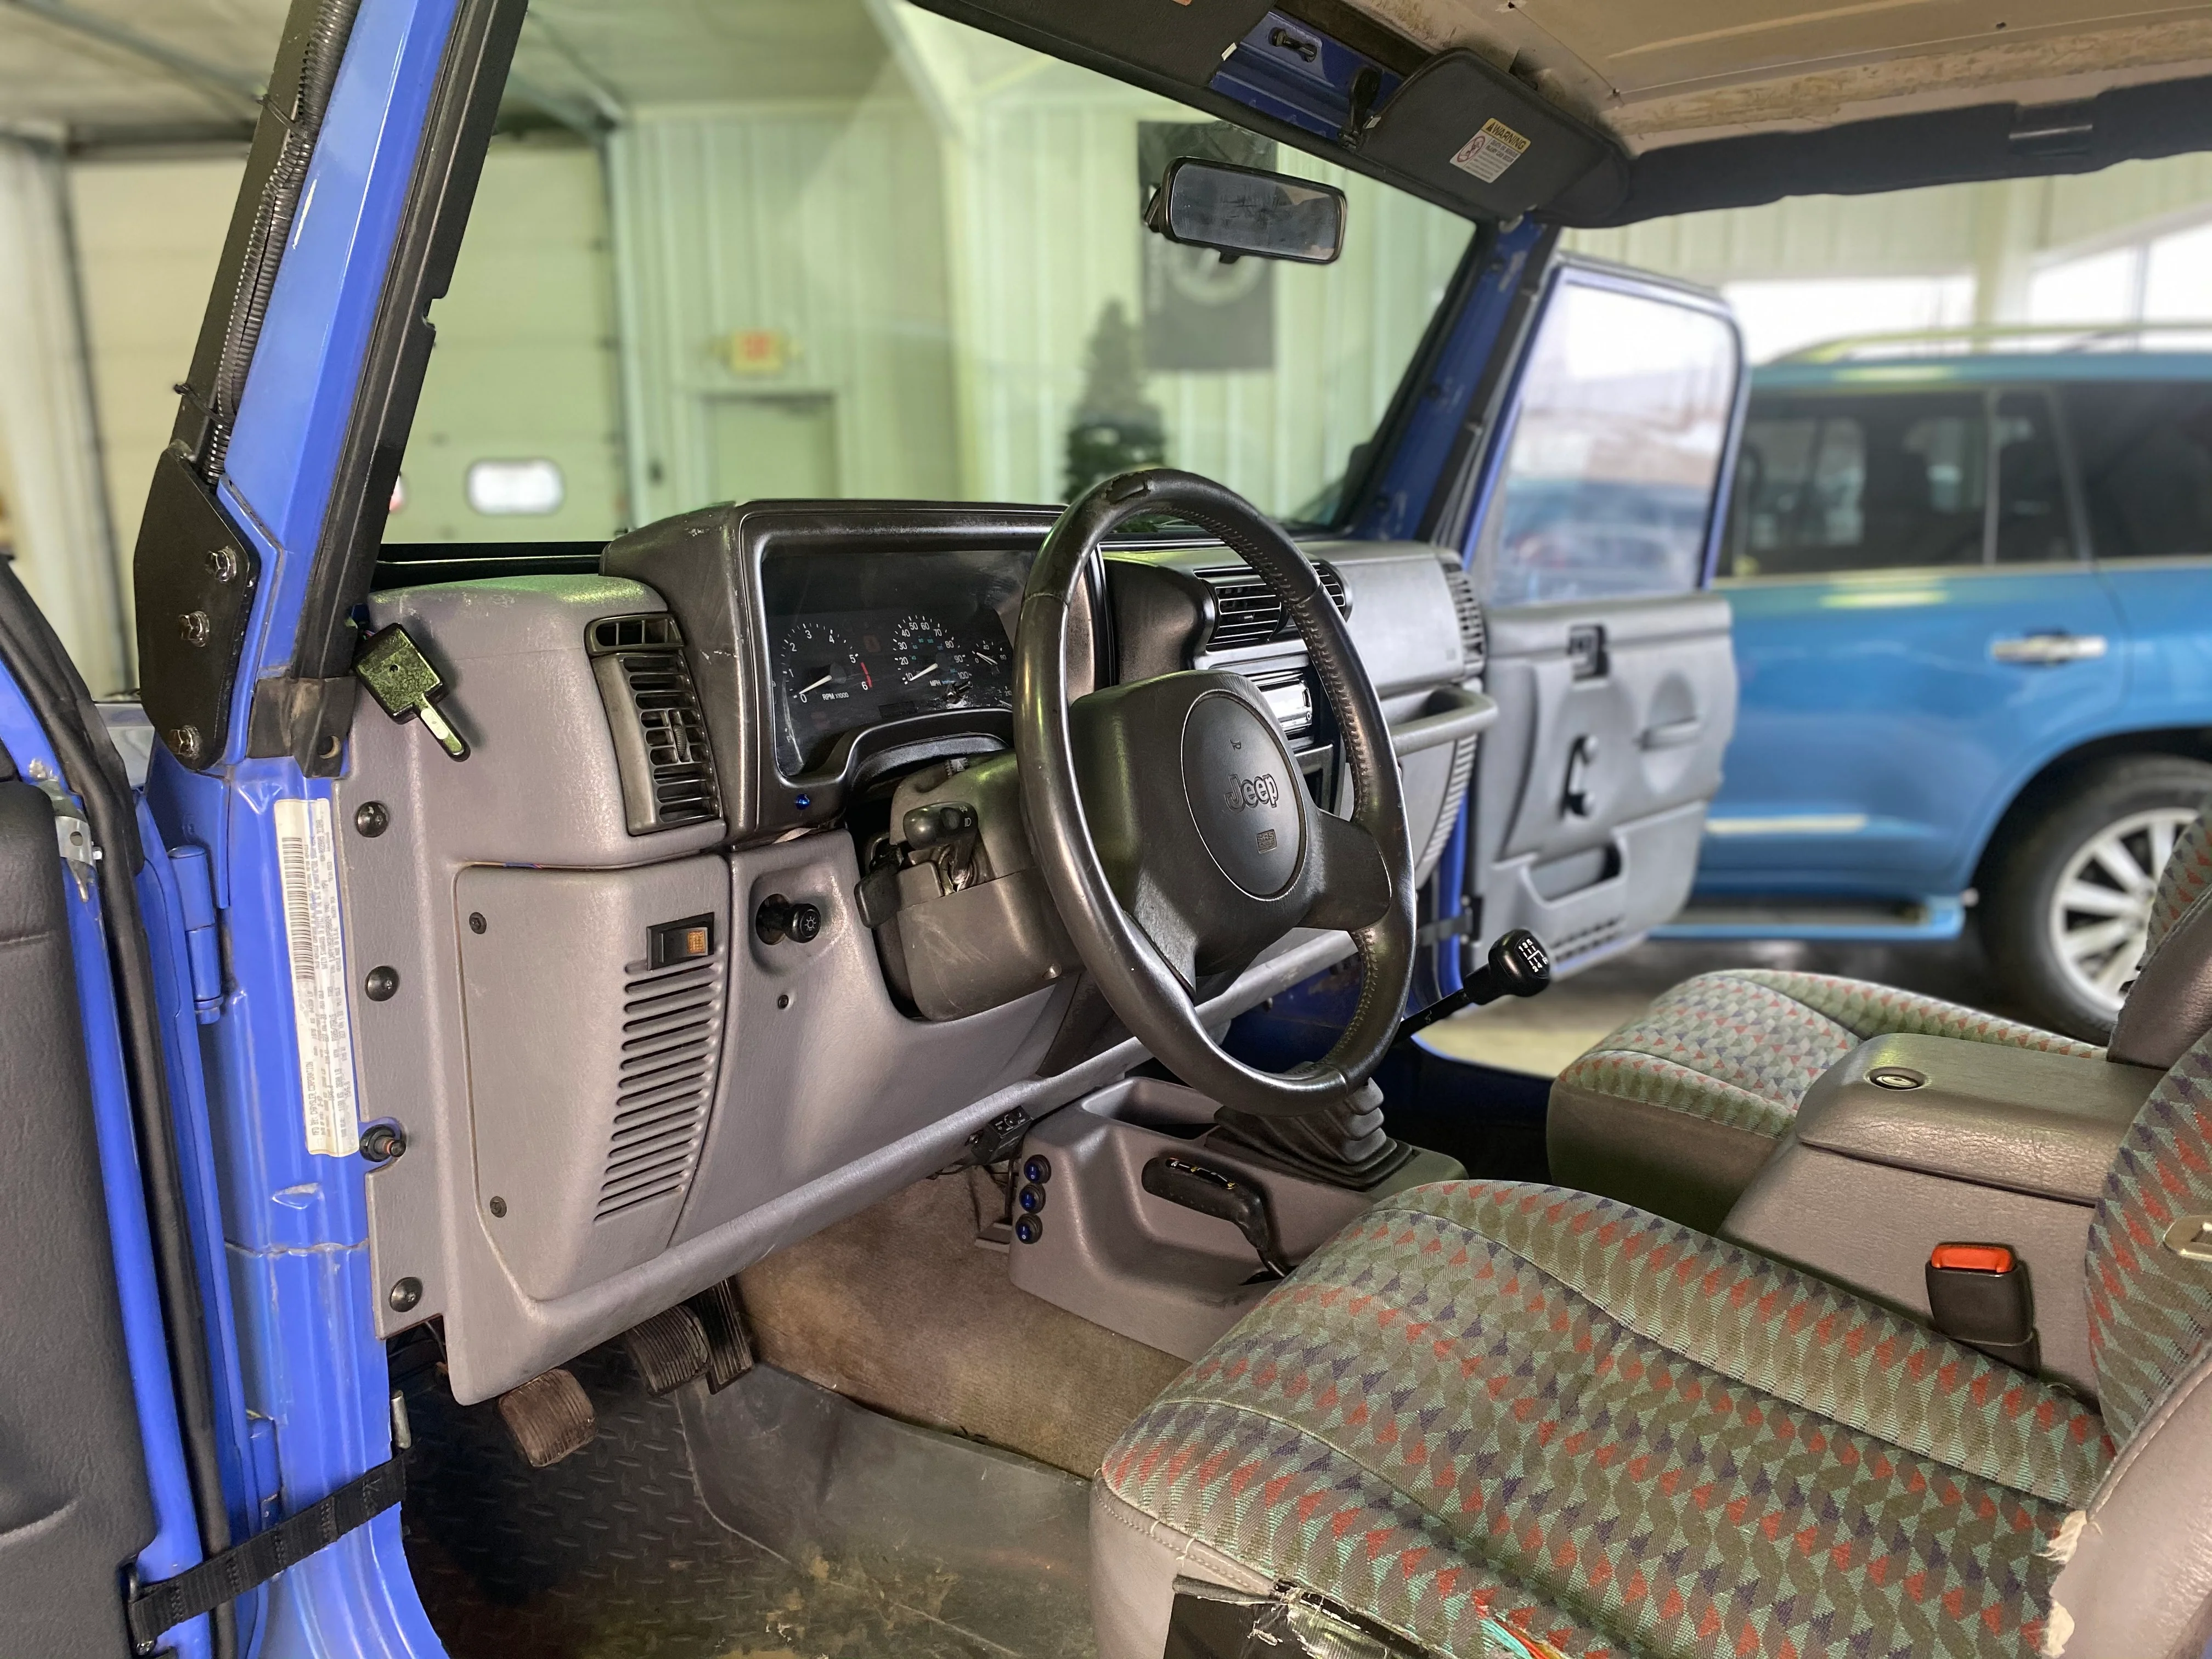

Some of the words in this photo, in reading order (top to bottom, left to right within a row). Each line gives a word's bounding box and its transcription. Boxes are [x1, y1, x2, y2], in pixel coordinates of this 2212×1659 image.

[1492, 123, 1527, 150] WARNING
[909, 622, 918, 630] 50
[921, 622, 930, 630] 60
[805, 630, 812, 639] 3
[934, 629, 943, 637] 70
[829, 635, 834, 644] 4
[945, 640, 954, 648] 80
[789, 642, 797, 652] 2
[898, 642, 907, 650] 30
[849, 654, 856, 663] 5
[899, 657, 909, 665] 20
[954, 654, 963, 663] 90
[788, 668, 794, 678] 1
[957, 671, 969, 680] 100
[861, 681, 868, 690] 6
[800, 694, 807, 703] 0
[1224, 774, 1279, 812] Jeep
[305, 1061, 315, 1091] CORPORATION
[308, 1091, 318, 1115] CHRYSLER
